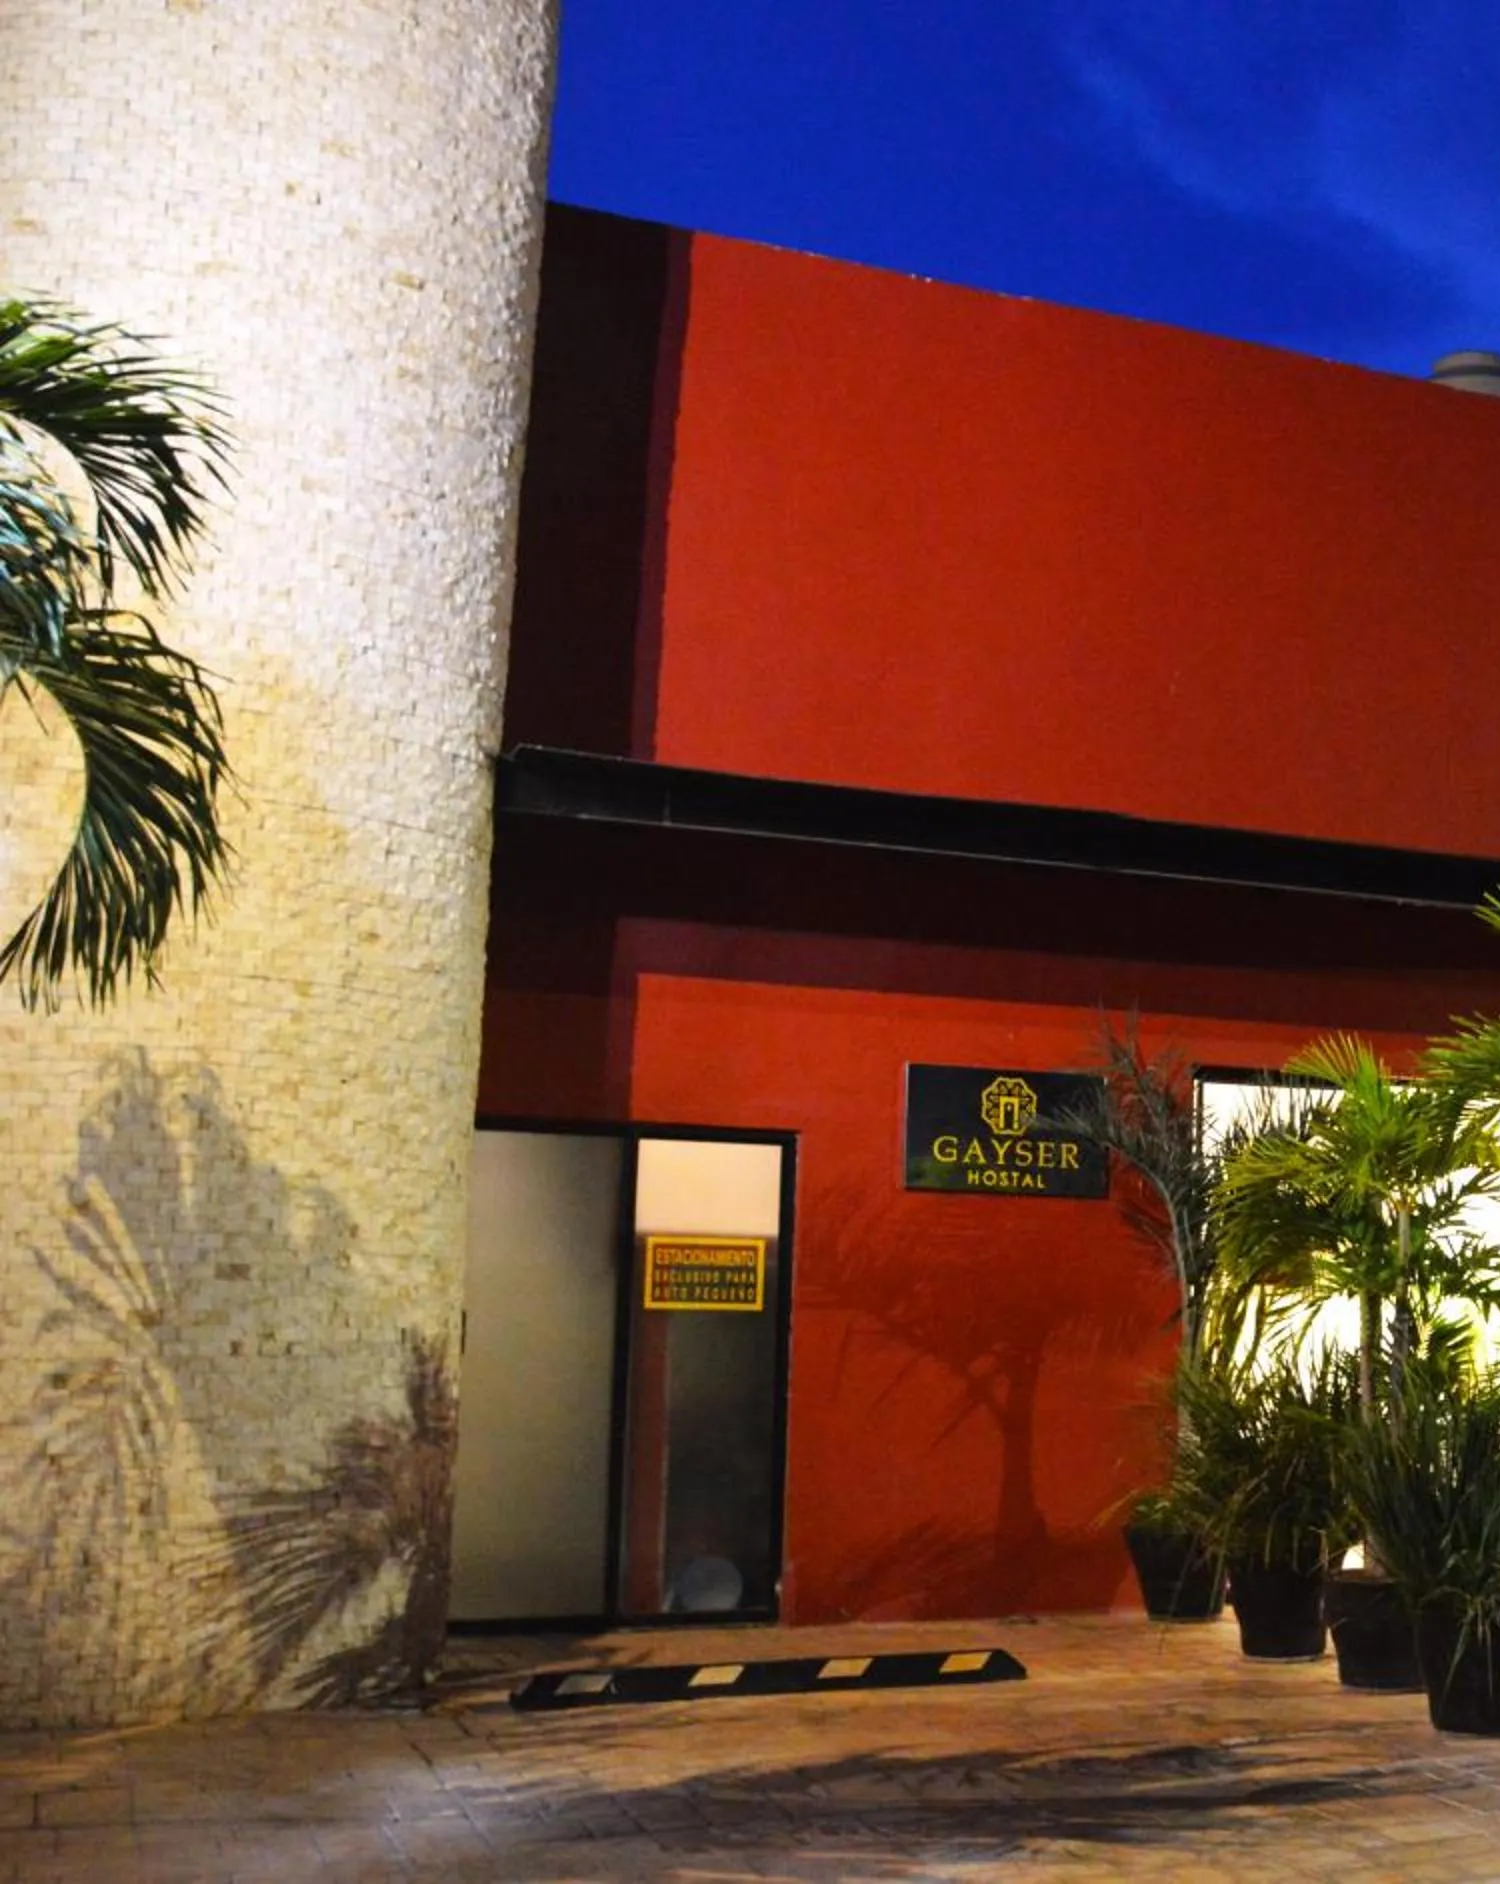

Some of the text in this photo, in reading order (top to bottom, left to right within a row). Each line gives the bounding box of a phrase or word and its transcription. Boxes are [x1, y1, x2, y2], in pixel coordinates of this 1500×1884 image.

[932, 1135, 1080, 1169] GAYSER
[966, 1169, 1046, 1189] HOSTAL
[655, 1247, 756, 1267] ESTACIONAMIENTO
